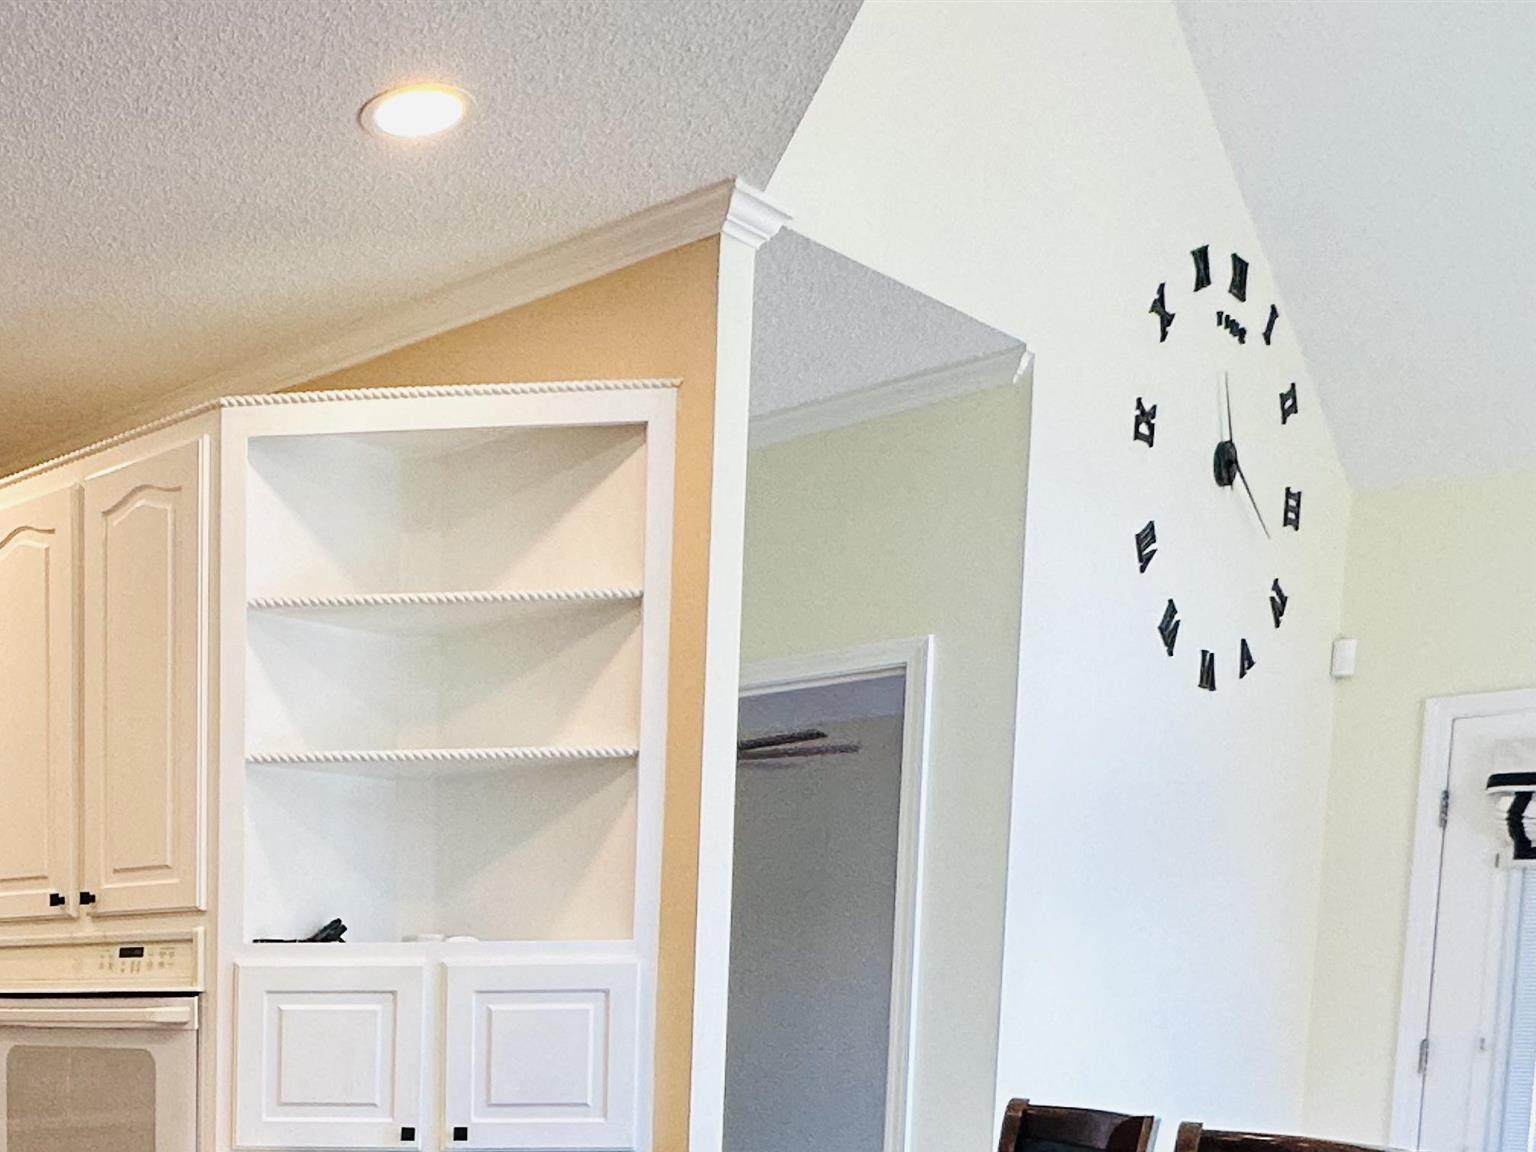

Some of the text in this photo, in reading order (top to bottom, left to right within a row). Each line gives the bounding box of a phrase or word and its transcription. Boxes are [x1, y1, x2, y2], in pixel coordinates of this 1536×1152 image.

[1148, 282, 1176, 343] X
[1262, 303, 1280, 346] I
[1133, 396, 1158, 449] IX
[1278, 382, 1299, 425] II
[1282, 486, 1303, 532] III
[1269, 577, 1289, 629] IV
[1197, 649, 1217, 692] VI
[1238, 638, 1256, 680] V
